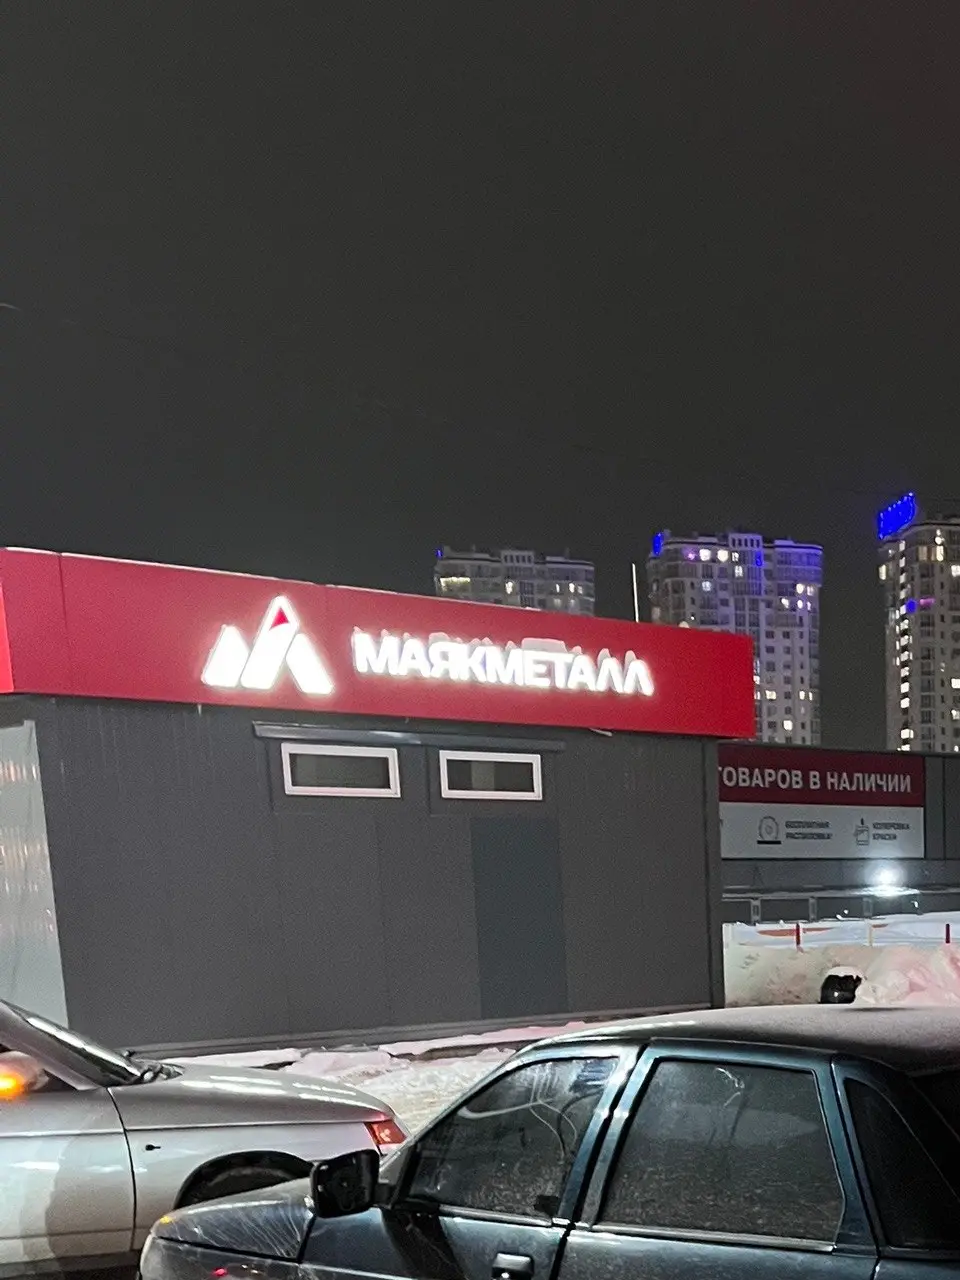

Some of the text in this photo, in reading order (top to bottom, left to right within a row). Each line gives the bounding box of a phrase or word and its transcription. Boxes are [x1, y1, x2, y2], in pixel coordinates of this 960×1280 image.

[353, 629, 655, 697] МАЯКМЕТАЛЛ
[718, 766, 911, 793] ОВАРОВ В НАЛИЧИИ
